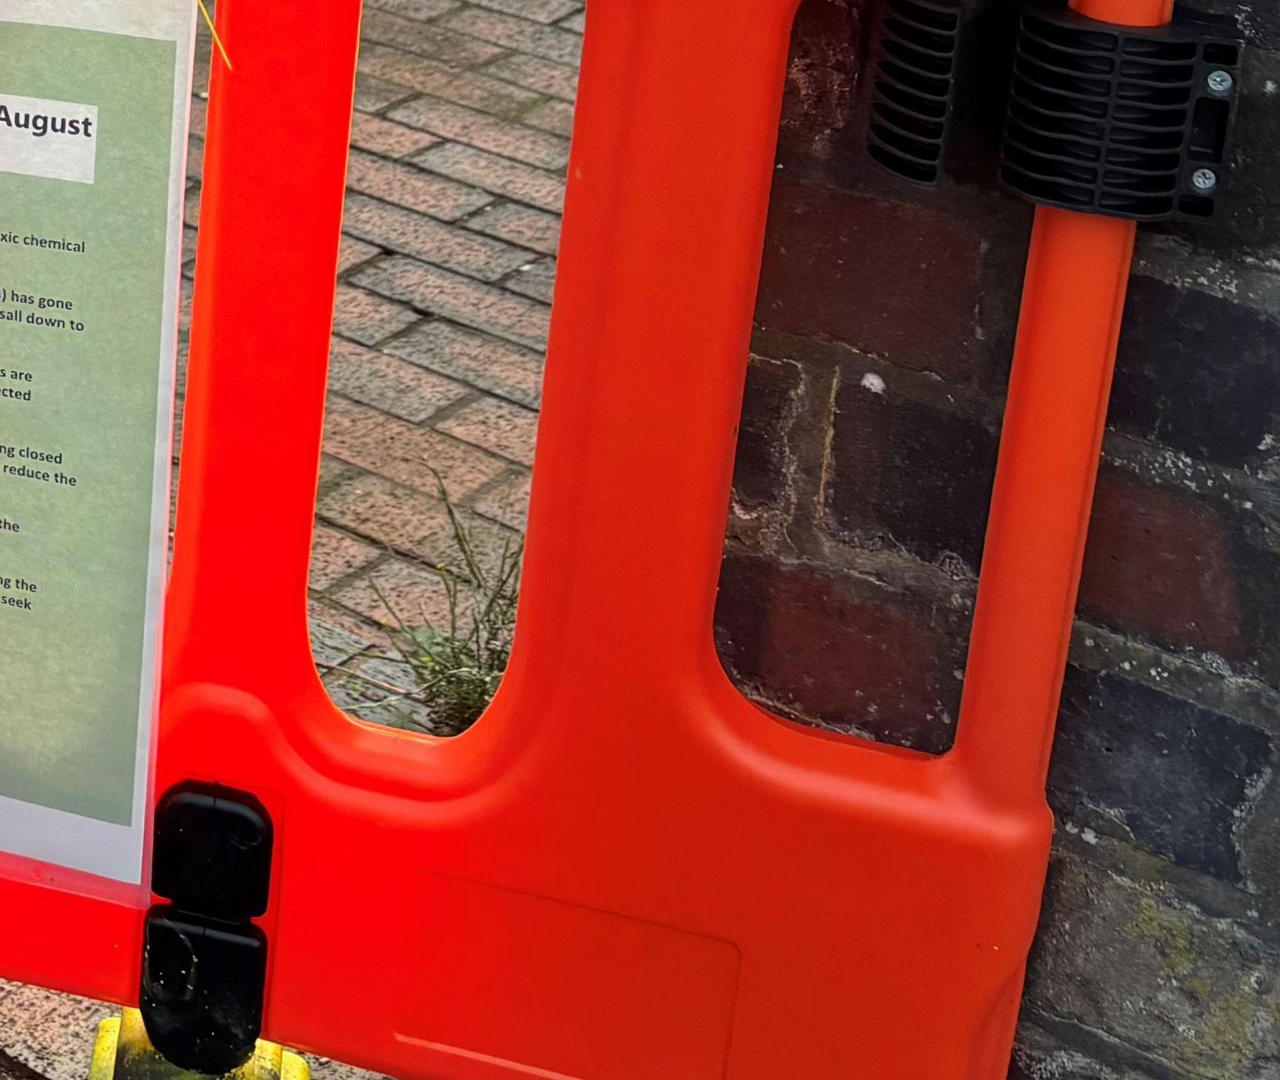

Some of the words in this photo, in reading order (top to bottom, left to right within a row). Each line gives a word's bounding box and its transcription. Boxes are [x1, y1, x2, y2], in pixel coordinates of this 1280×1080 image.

[23, 235, 85, 252] chemical
[11, 290, 34, 304] has
[38, 298, 73, 310] gone
[26, 313, 65, 328] down
[70, 320, 84, 331] to
[11, 371, 32, 382] are
[19, 447, 62, 464] closed
